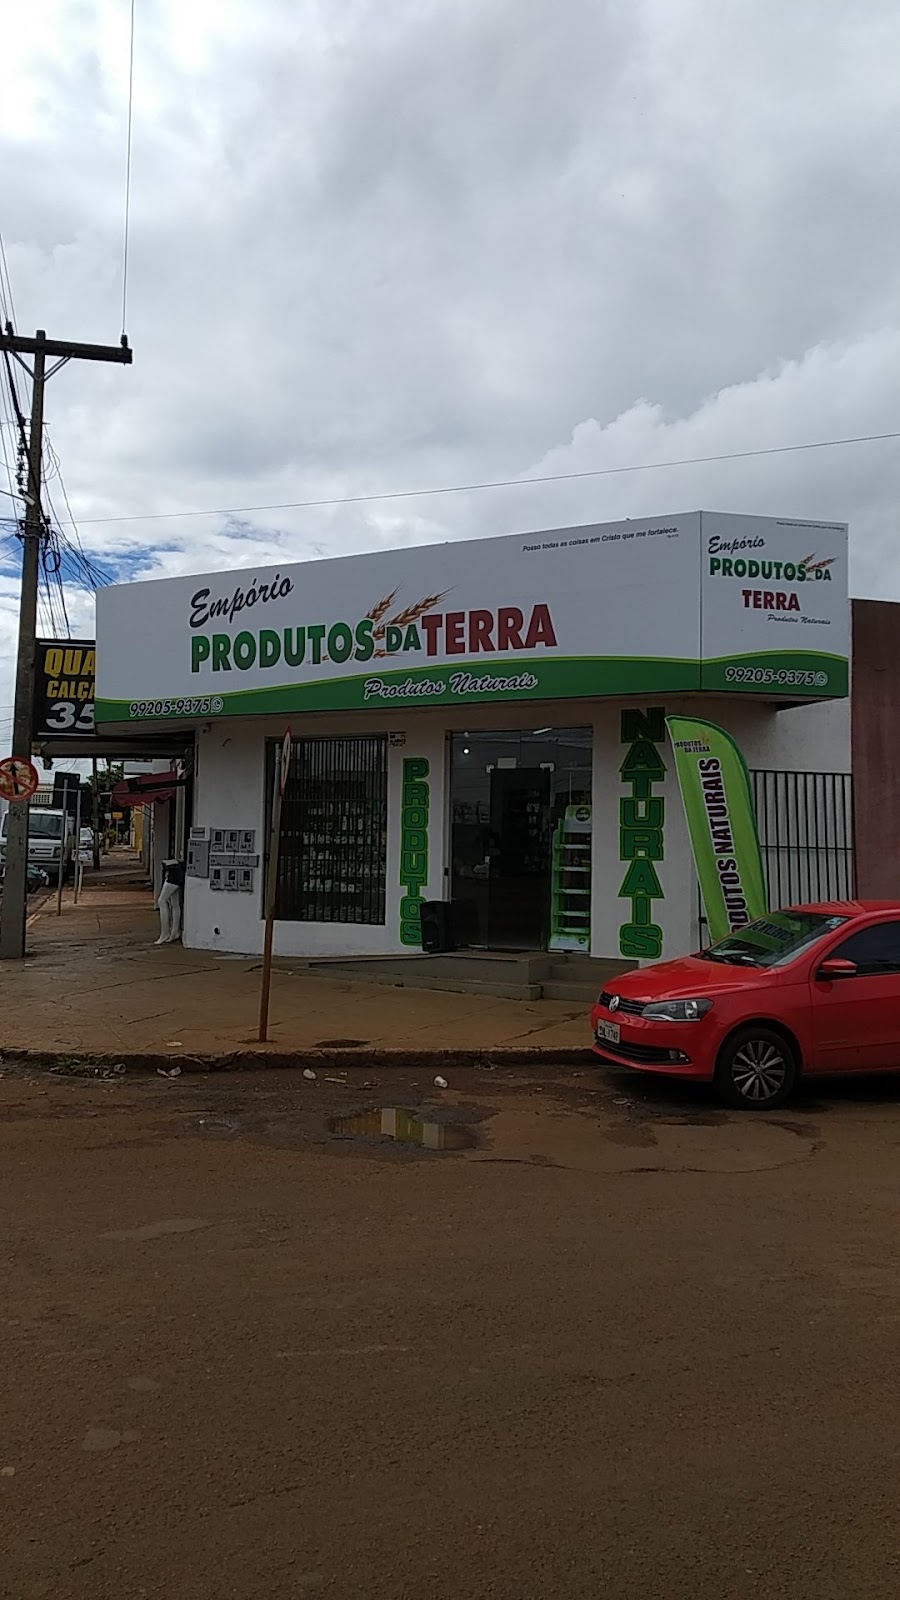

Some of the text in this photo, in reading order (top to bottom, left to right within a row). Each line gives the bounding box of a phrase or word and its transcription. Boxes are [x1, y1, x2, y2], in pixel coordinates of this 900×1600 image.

[601, 534, 621, 542] Cristo
[708, 536, 766, 555] Empório
[709, 557, 832, 582] PRODUTOS DA
[189, 573, 295, 629] Empório
[742, 589, 801, 612] TERRA
[191, 604, 558, 673] PRODUTOS DA TERRA
[364, 672, 538, 700] Produtos Naturais
[724, 666, 816, 686] 99205-9375
[45, 701, 96, 730] 35
[129, 698, 210, 717] 99205-9375
[698, 757, 734, 855] NATURAIS
[617, 707, 668, 959] NATURAIS
[400, 757, 430, 946] PRODUTOS
